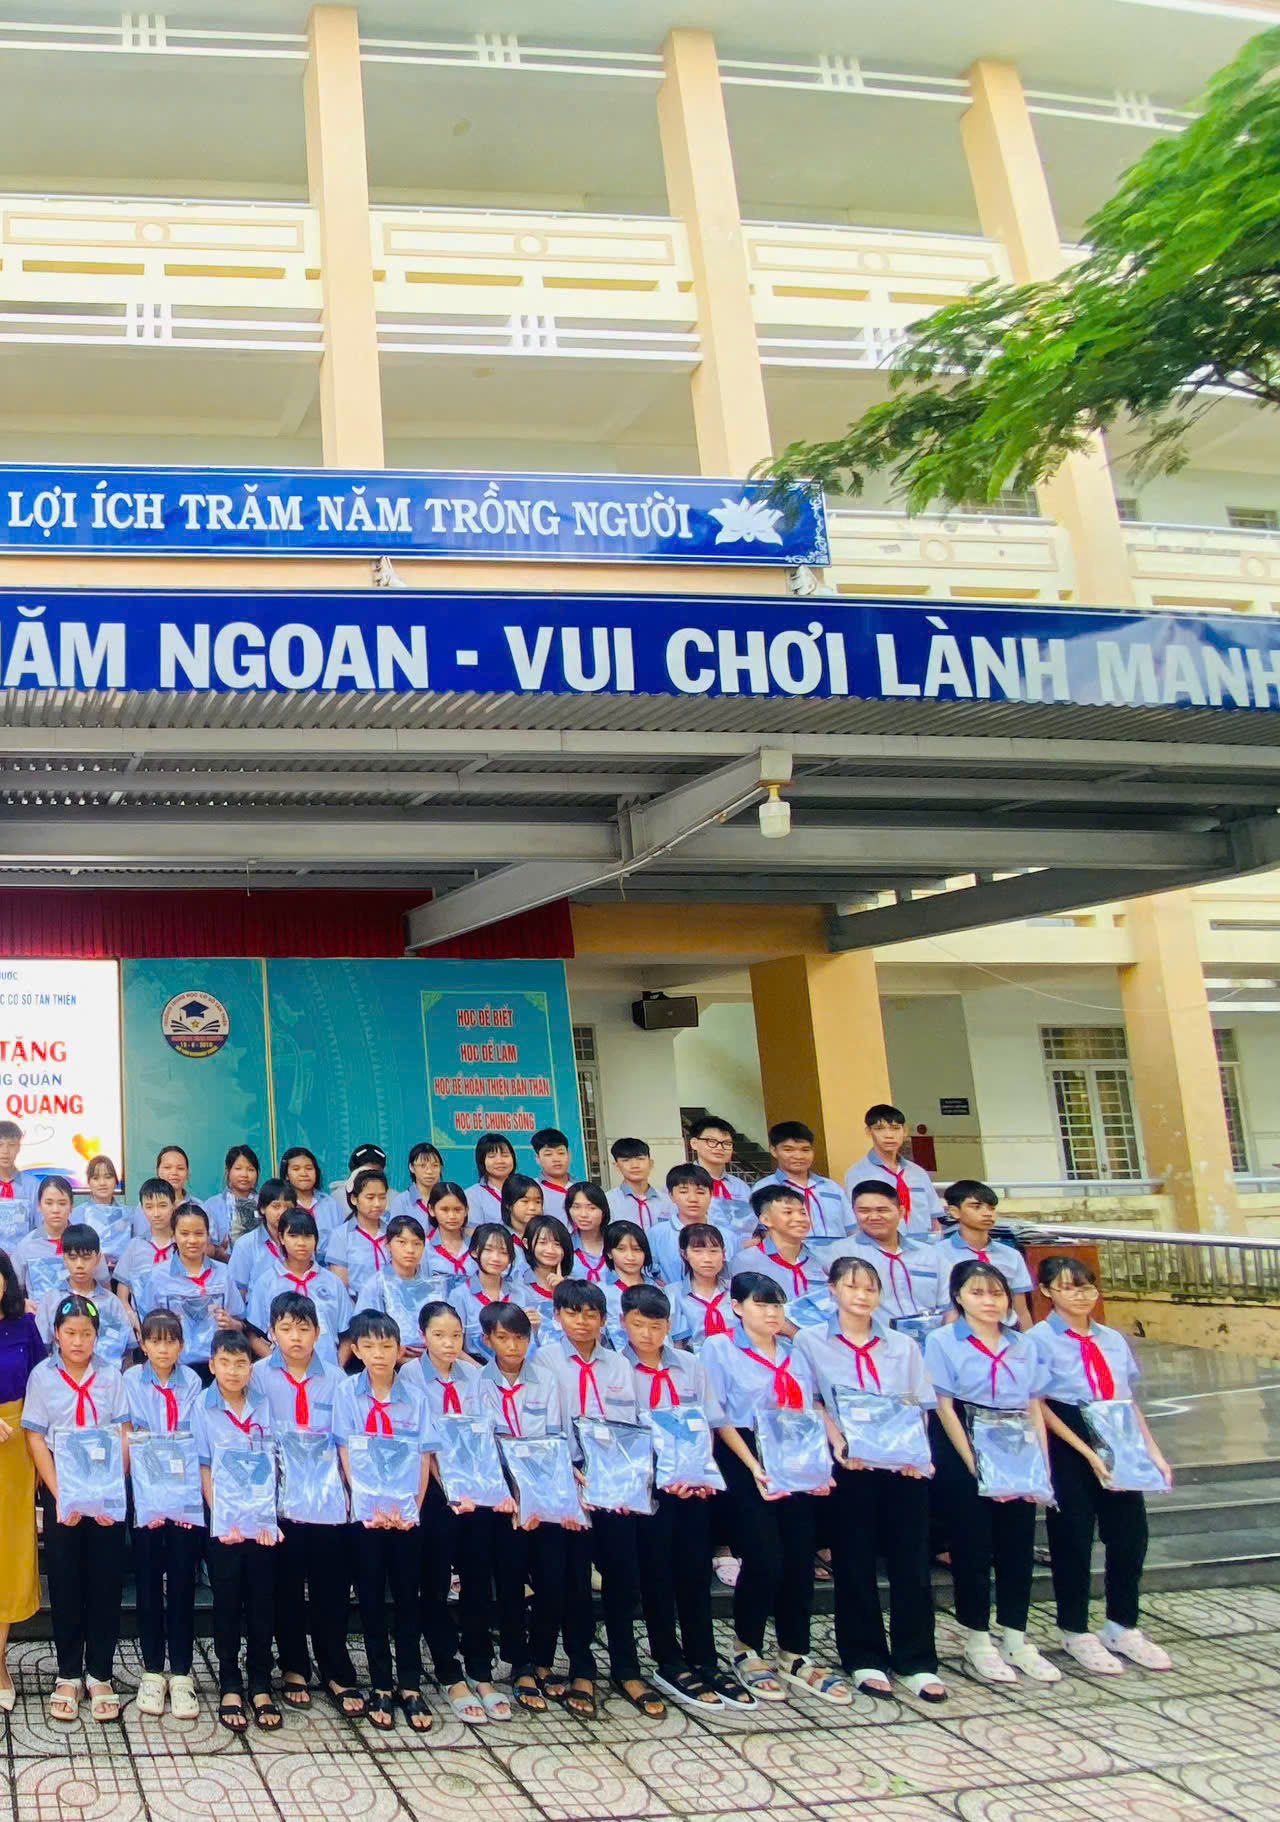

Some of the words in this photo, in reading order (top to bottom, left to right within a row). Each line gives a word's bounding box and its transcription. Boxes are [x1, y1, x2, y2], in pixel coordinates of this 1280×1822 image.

[8, 485, 78, 538] LỢI
[91, 480, 165, 529] ÍCH
[179, 483, 304, 531] TRĂM
[317, 486, 413, 532] NĂM
[424, 480, 561, 536] TRỒNG
[572, 491, 693, 538] NGƯỜI
[160, 621, 429, 689] NGOAN
[503, 626, 635, 692] VUI
[666, 621, 849, 694] CHƠI
[876, 616, 1071, 701] LÀNH
[456, 1008, 477, 1031] HỌC
[6, 1094, 85, 1119] QUANG
[484, 1111, 513, 1131] CHUNG
